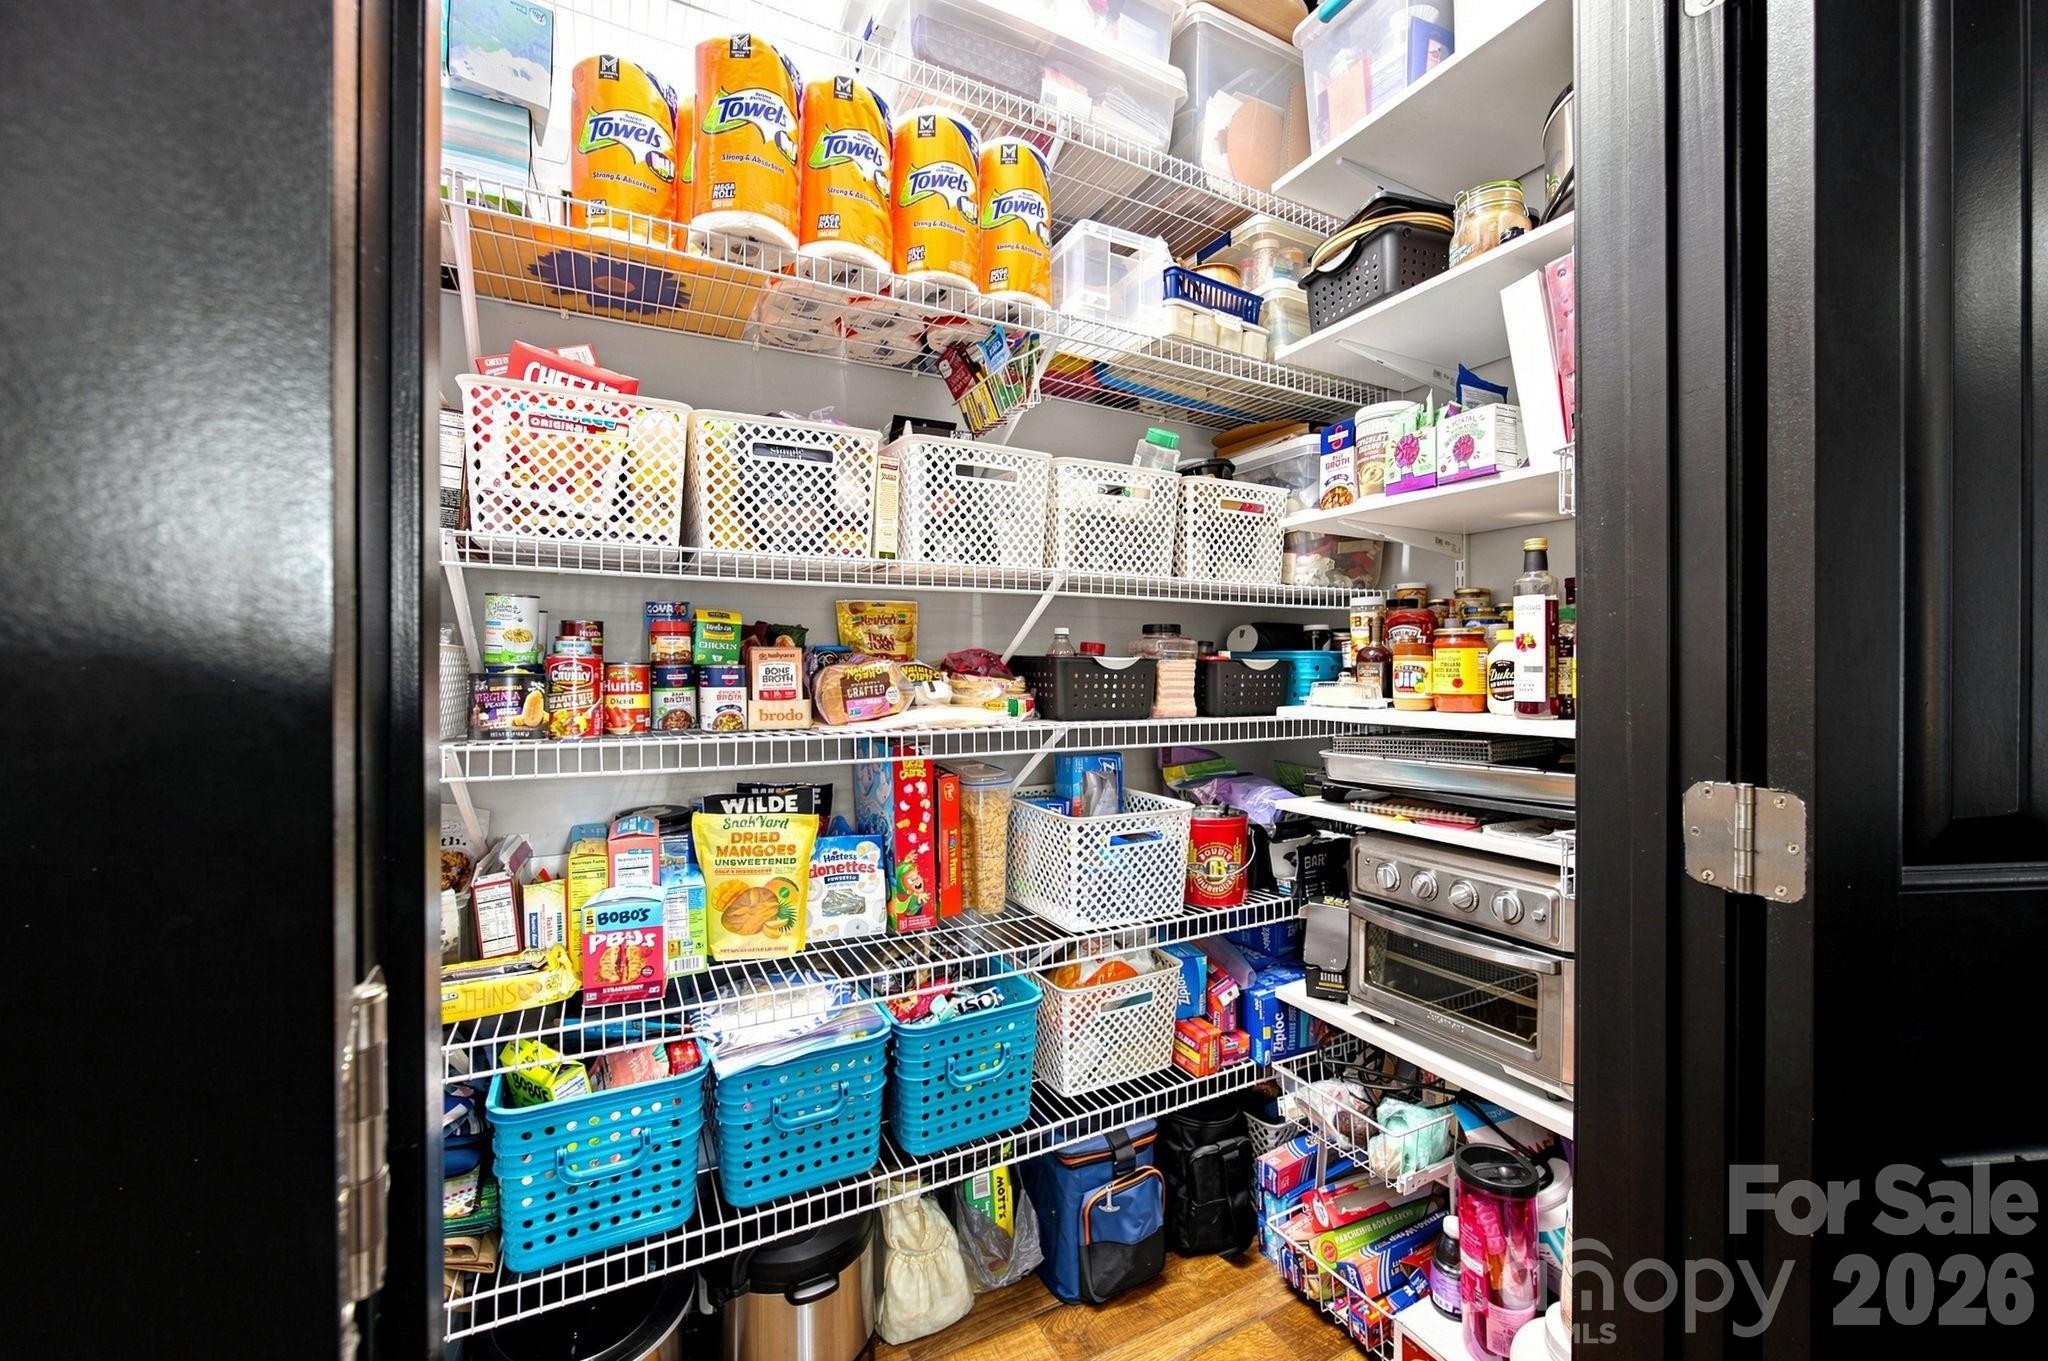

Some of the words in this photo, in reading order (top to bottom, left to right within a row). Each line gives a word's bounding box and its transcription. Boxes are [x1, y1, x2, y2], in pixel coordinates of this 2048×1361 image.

[718, 95, 787, 127] Towels
[589, 115, 662, 149] Towels
[823, 135, 884, 166] Towels
[722, 153, 744, 162] Strong
[752, 156, 785, 174] Absorbent
[593, 171, 614, 181] Strong
[623, 175, 657, 193] Absorbent
[713, 182, 735, 192] MEGA
[909, 170, 968, 196] Towels
[712, 190, 735, 200] ROLL
[992, 197, 1046, 221] Towels
[819, 214, 840, 223] MEGA
[818, 221, 840, 230] ROLL
[1325, 457, 1350, 470] BROTH
[699, 641, 737, 650] CHICKEN
[765, 666, 790, 675] BONE
[762, 674, 793, 683] BROTH
[610, 697, 634, 705] Diced
[664, 696, 692, 704] BROTH
[759, 708, 804, 721] brodo
[720, 794, 798, 814] WILDE
[731, 831, 781, 844] DRIED
[716, 844, 796, 858] MANGOES
[823, 852, 857, 863] Hostess
[715, 857, 796, 867] UNSWEETENED
[809, 860, 875, 879] donettes
[586, 915, 594, 925] 5
[597, 908, 651, 926] BOBO'S
[602, 984, 644, 994] STRAWBERRY
[461, 981, 517, 1013] THINS
[1272, 1011, 1287, 1053] Ziploc
